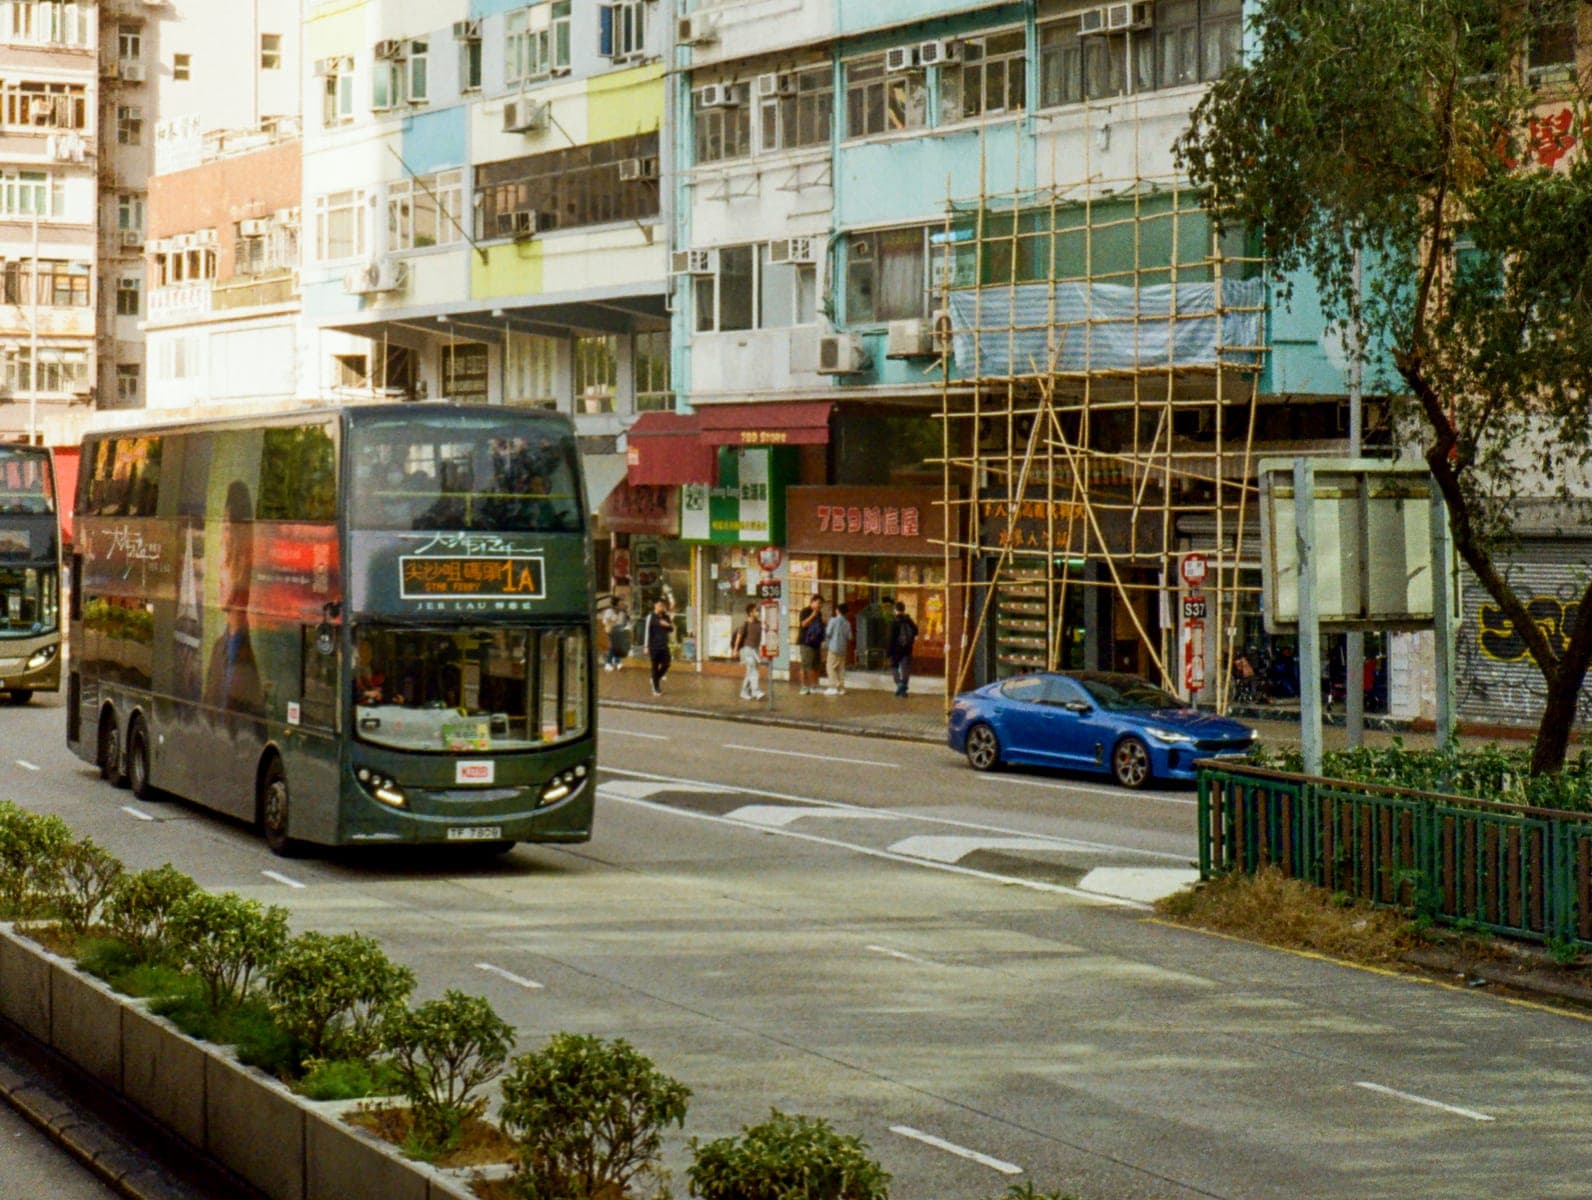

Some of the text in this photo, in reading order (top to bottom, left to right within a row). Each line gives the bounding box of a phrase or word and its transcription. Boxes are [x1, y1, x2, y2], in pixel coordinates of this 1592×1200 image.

[502, 559, 535, 593] 1A
[455, 601, 487, 611] LAU
[1184, 602, 1205, 617] S37
